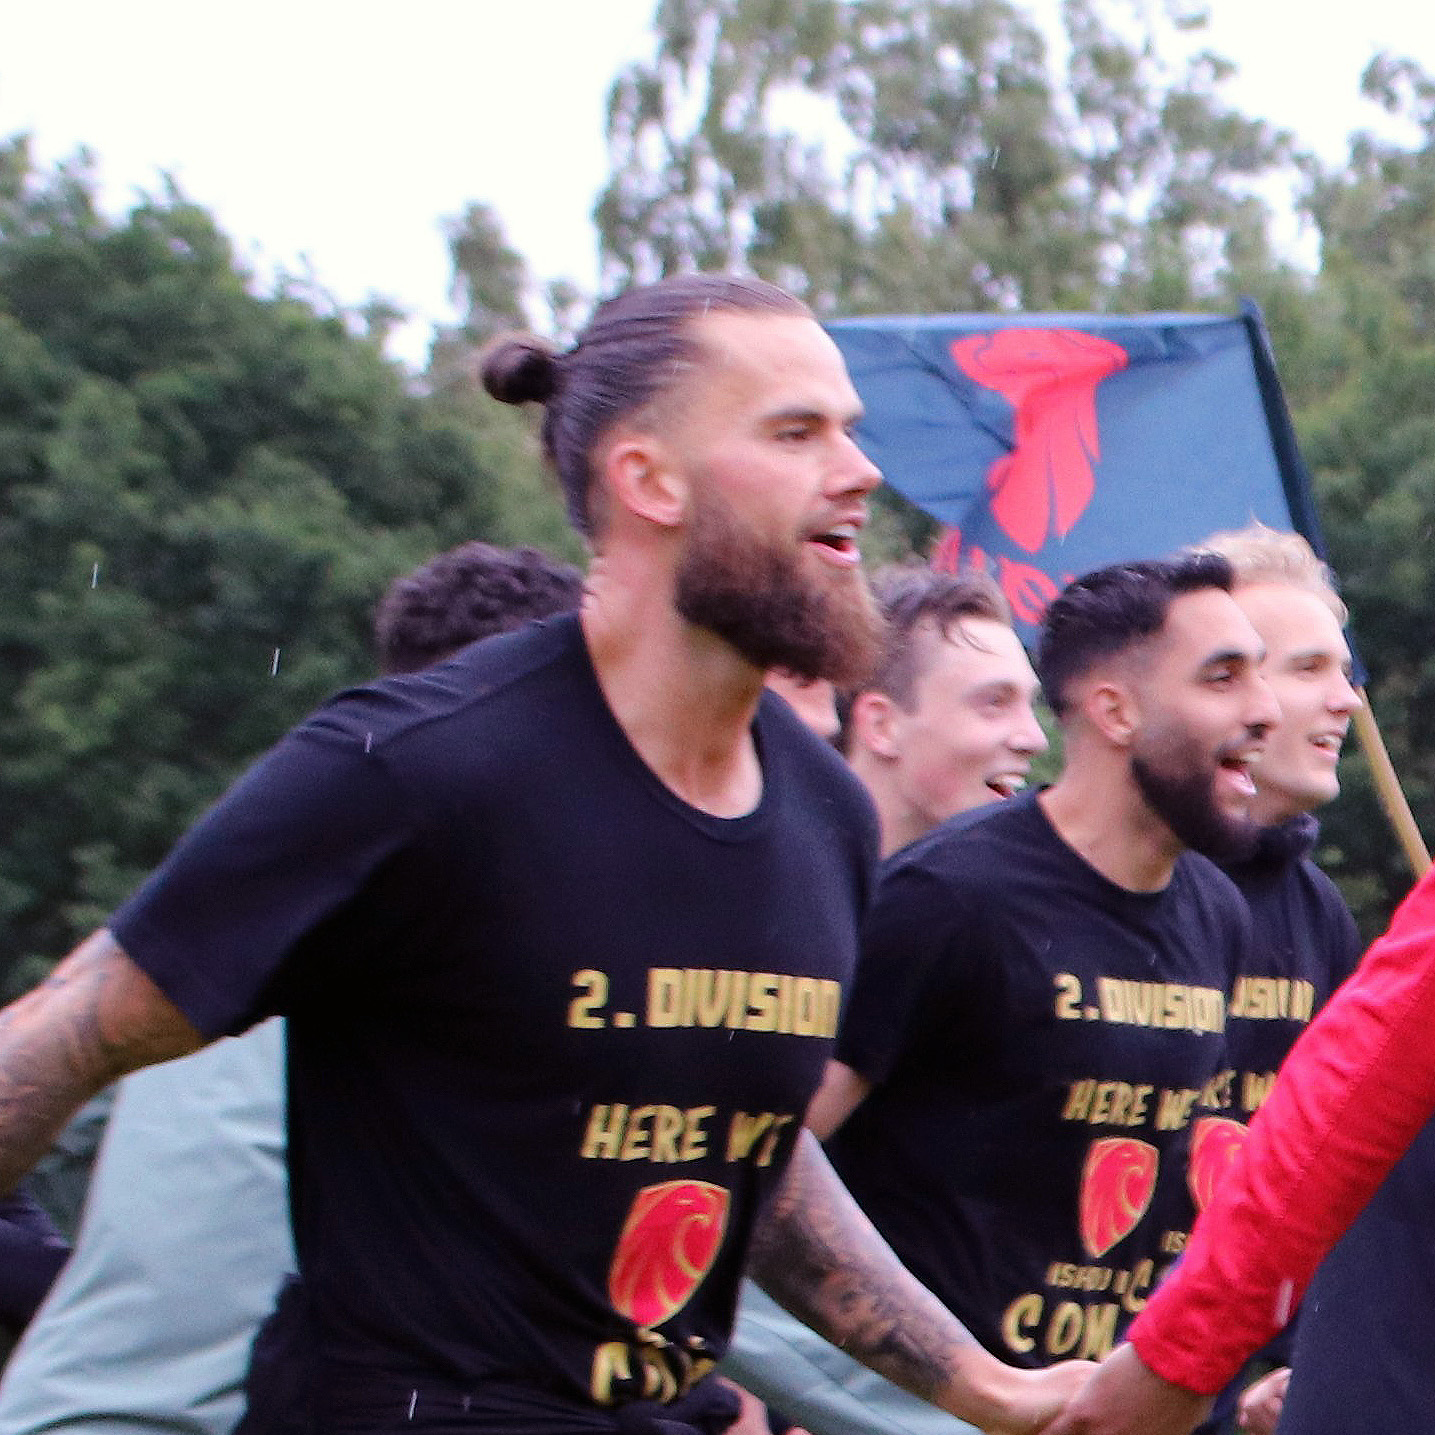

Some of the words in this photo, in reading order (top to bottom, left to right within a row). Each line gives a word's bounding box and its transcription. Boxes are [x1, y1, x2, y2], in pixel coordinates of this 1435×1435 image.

[567, 968, 636, 1029] 2.
[645, 967, 842, 1039] DIVISION
[580, 1103, 717, 1163] HERE
[1001, 1293, 1122, 1361] COM
